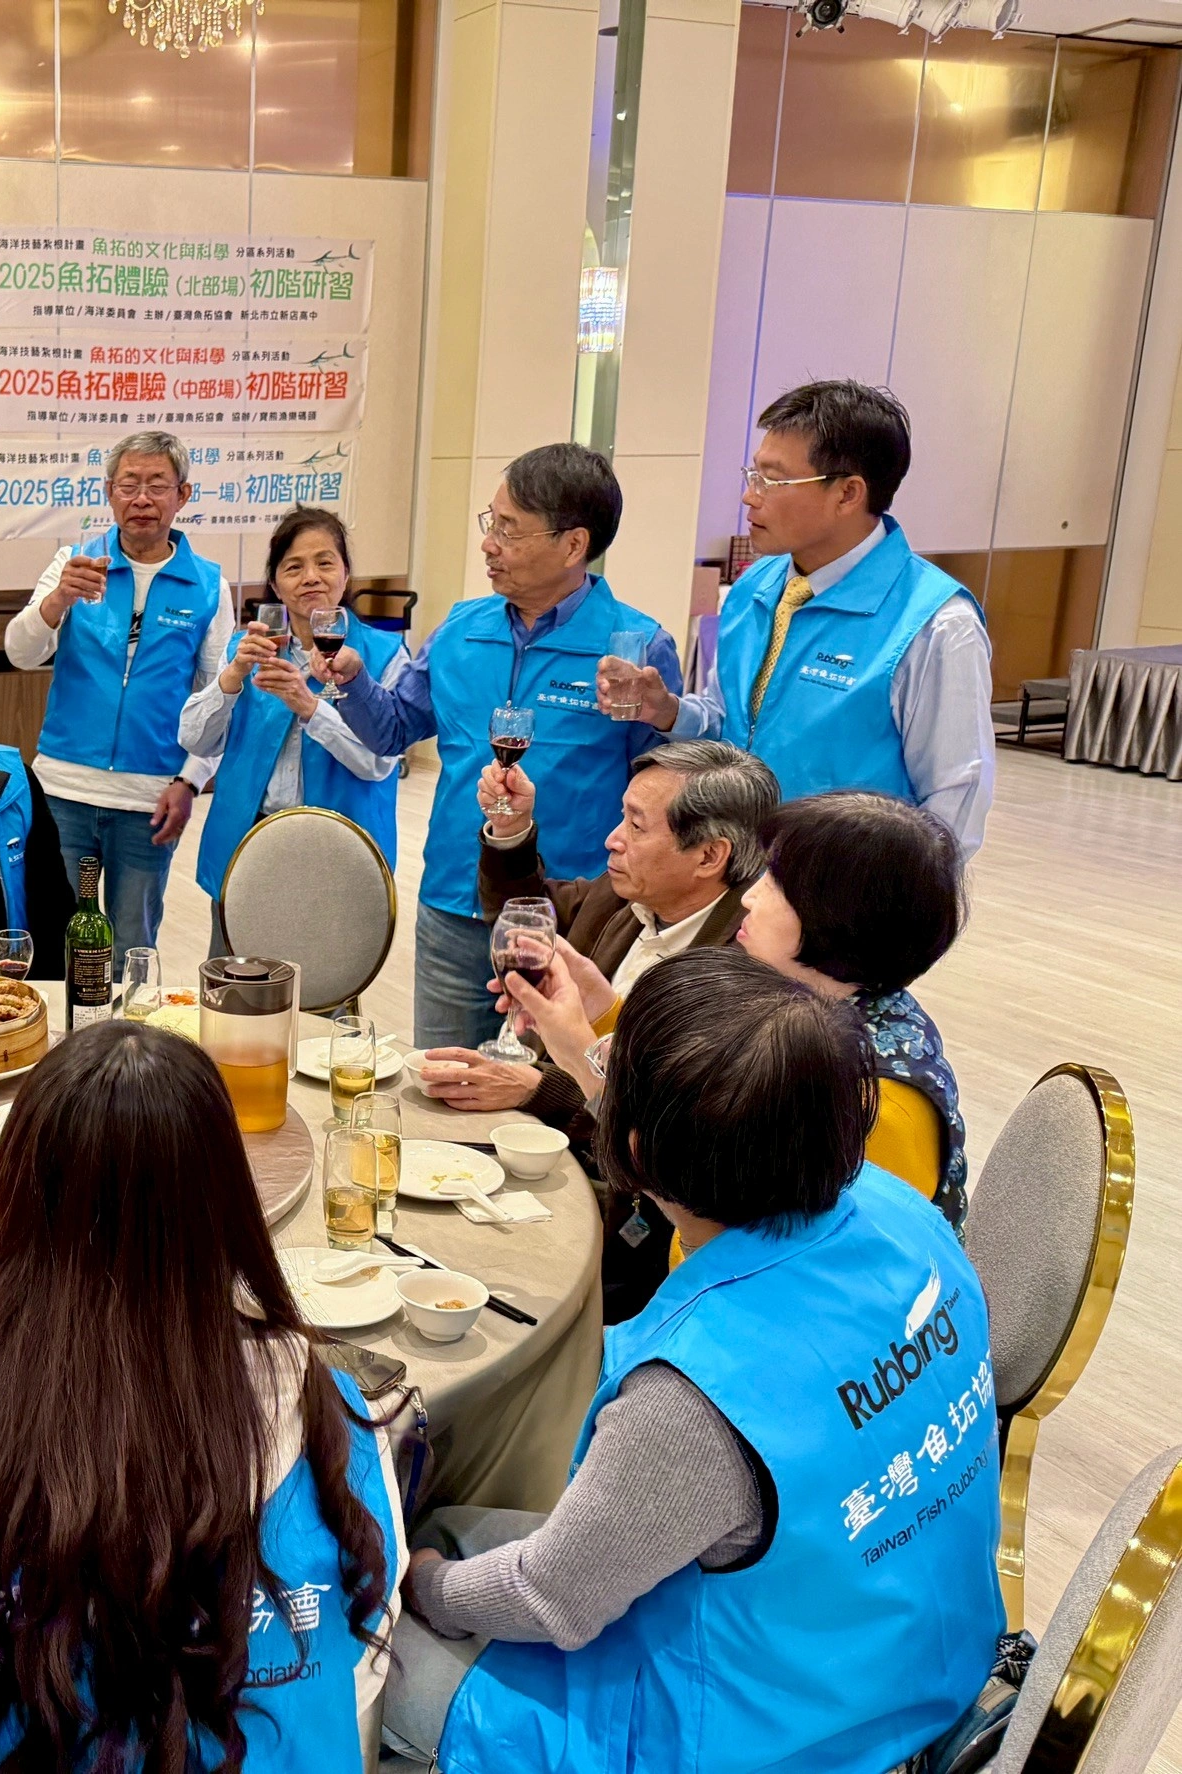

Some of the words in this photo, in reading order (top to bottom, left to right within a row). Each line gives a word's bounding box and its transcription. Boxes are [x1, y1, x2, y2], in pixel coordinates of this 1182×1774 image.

[92, 237, 229, 261] 魚拓的文化與科學
[236, 247, 295, 259] 分區系列活動
[240, 309, 318, 321] 新北市立新店高中
[90, 346, 225, 365] 魚拓的文化與科學
[232, 351, 290, 361] 分區系列活動
[87, 448, 112, 466] 魚
[226, 451, 284, 462] 分區系列活動
[836, 1307, 959, 1430] Rubbing
[861, 1522, 916, 1568] Taiwan
[915, 1496, 946, 1533] Fish
